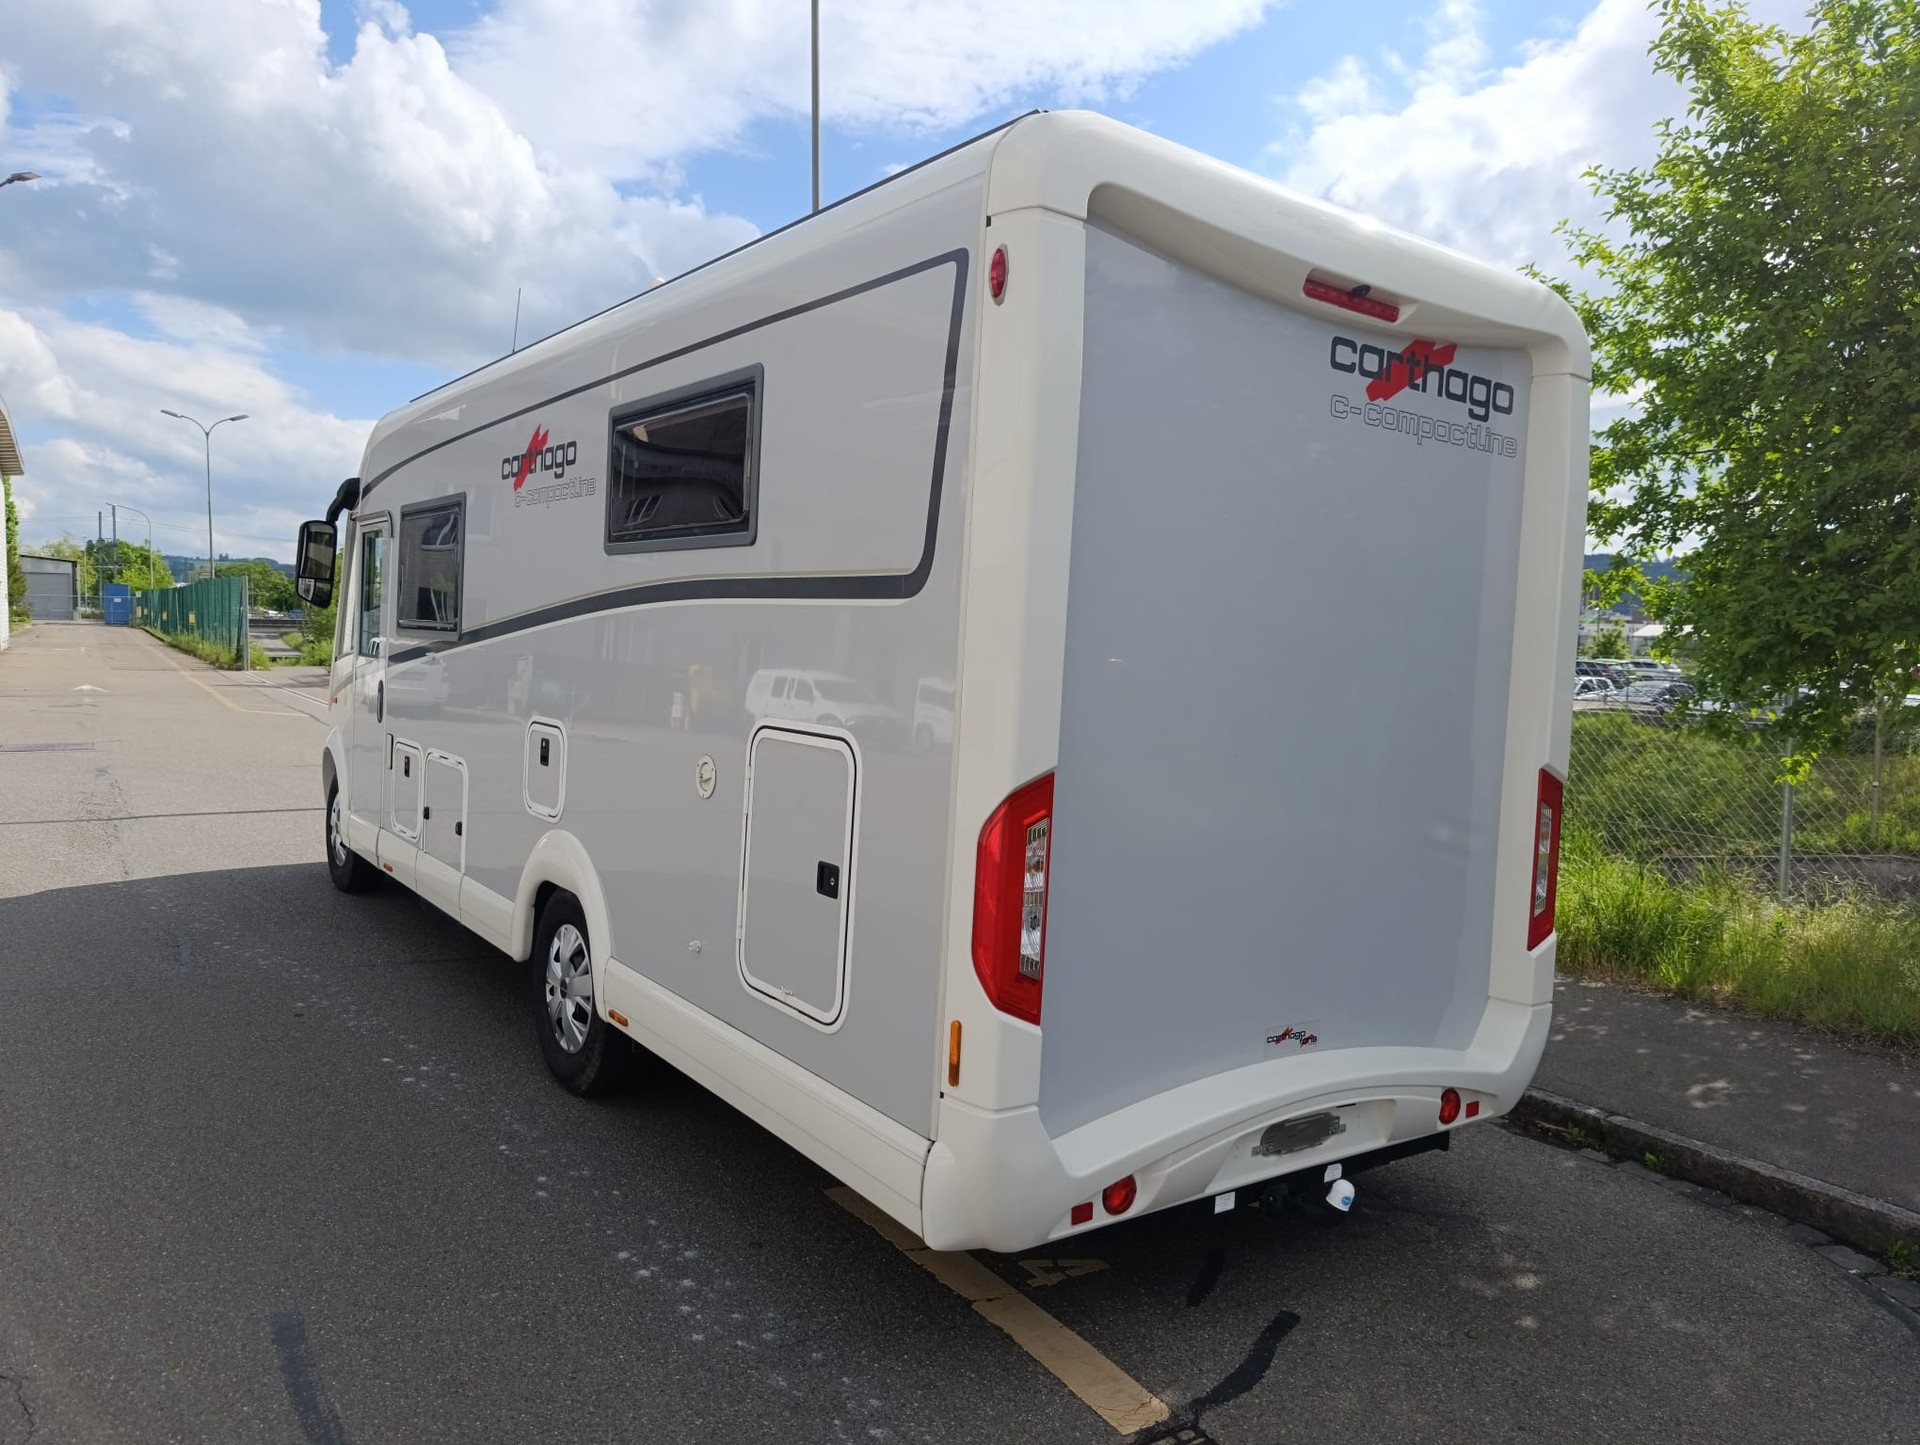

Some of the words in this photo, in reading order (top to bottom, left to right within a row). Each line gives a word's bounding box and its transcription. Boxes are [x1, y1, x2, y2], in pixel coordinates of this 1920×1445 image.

[1330, 336, 1514, 423] carthago
[1330, 395, 1518, 459] c-compactline
[502, 440, 577, 480] carthago
